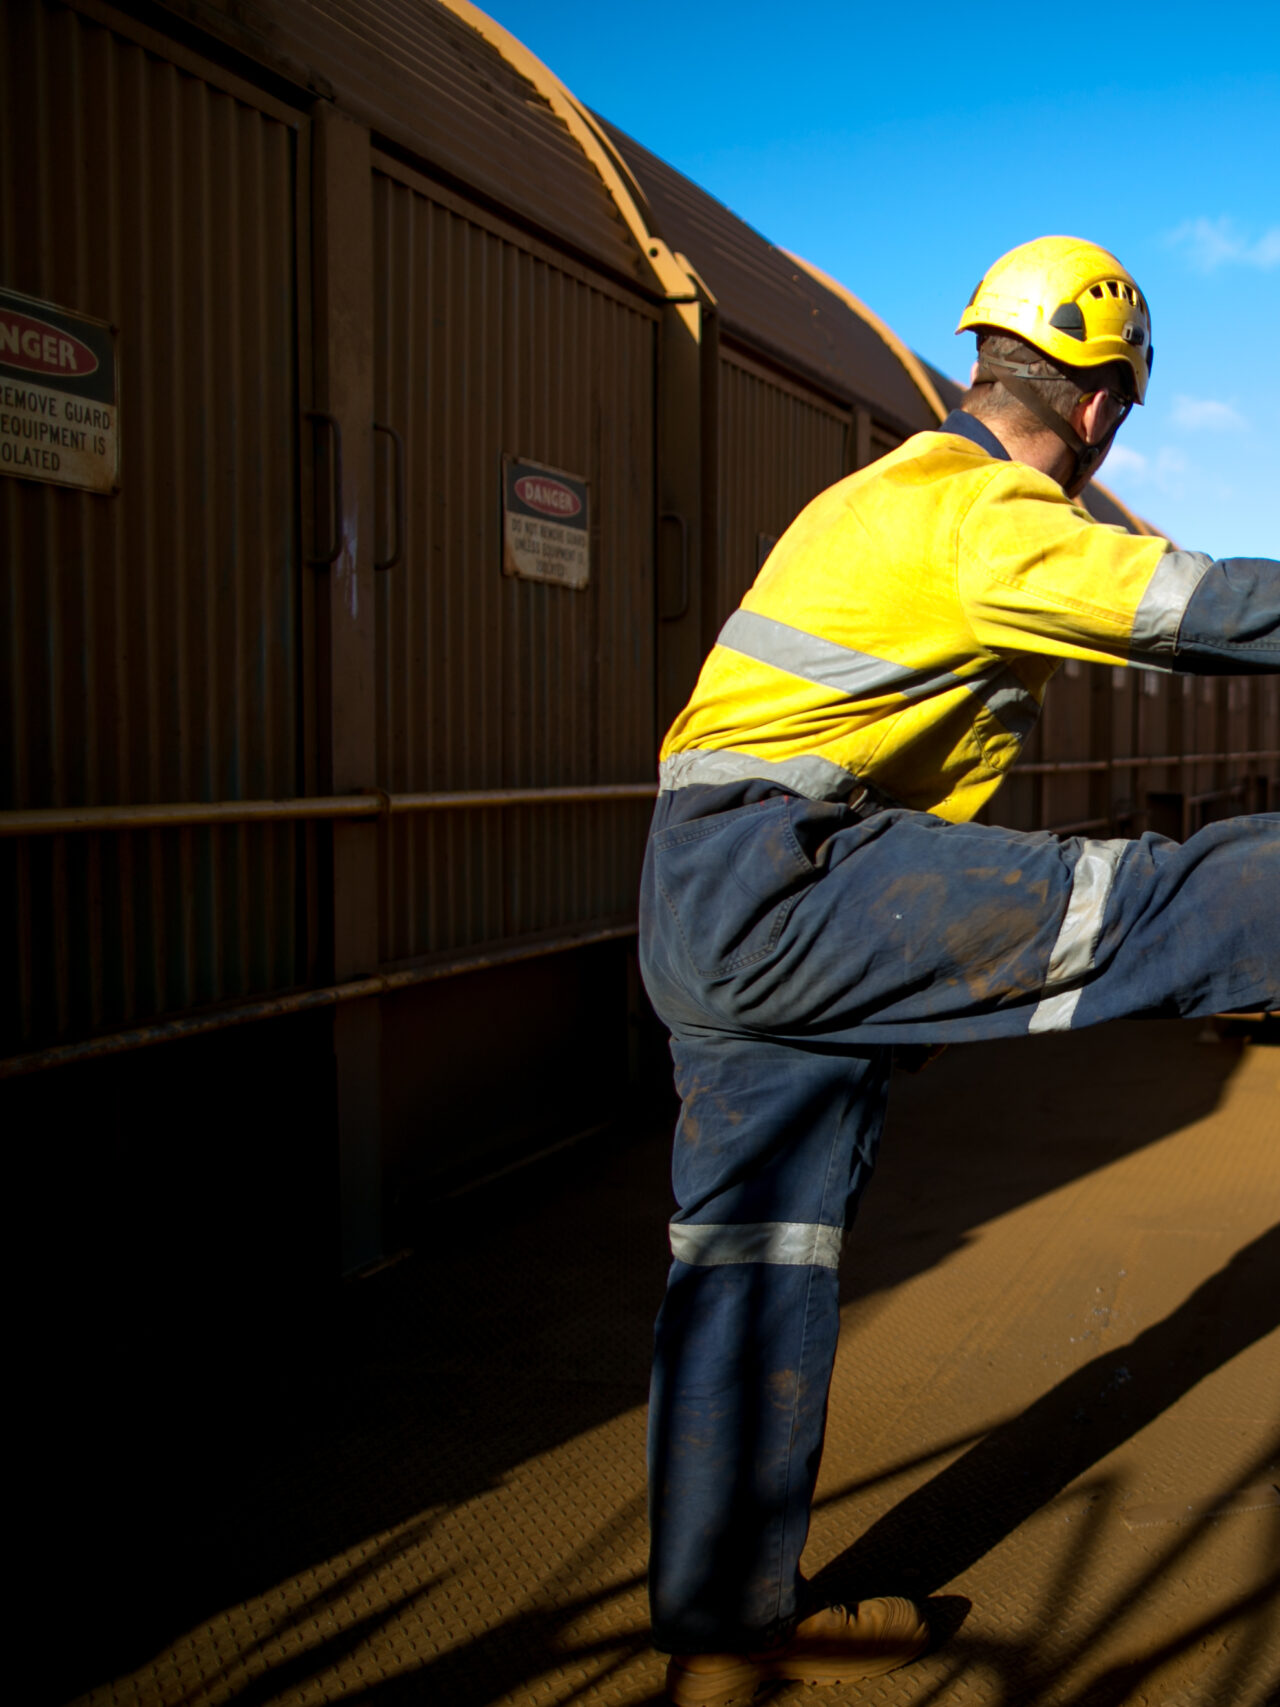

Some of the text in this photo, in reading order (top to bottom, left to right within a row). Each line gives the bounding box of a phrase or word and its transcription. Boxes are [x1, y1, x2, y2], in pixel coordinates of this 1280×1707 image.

[65, 402, 110, 430] GUARD
[1, 415, 105, 455] EQUIPMENT IS
[524, 481, 574, 511] DANGER
